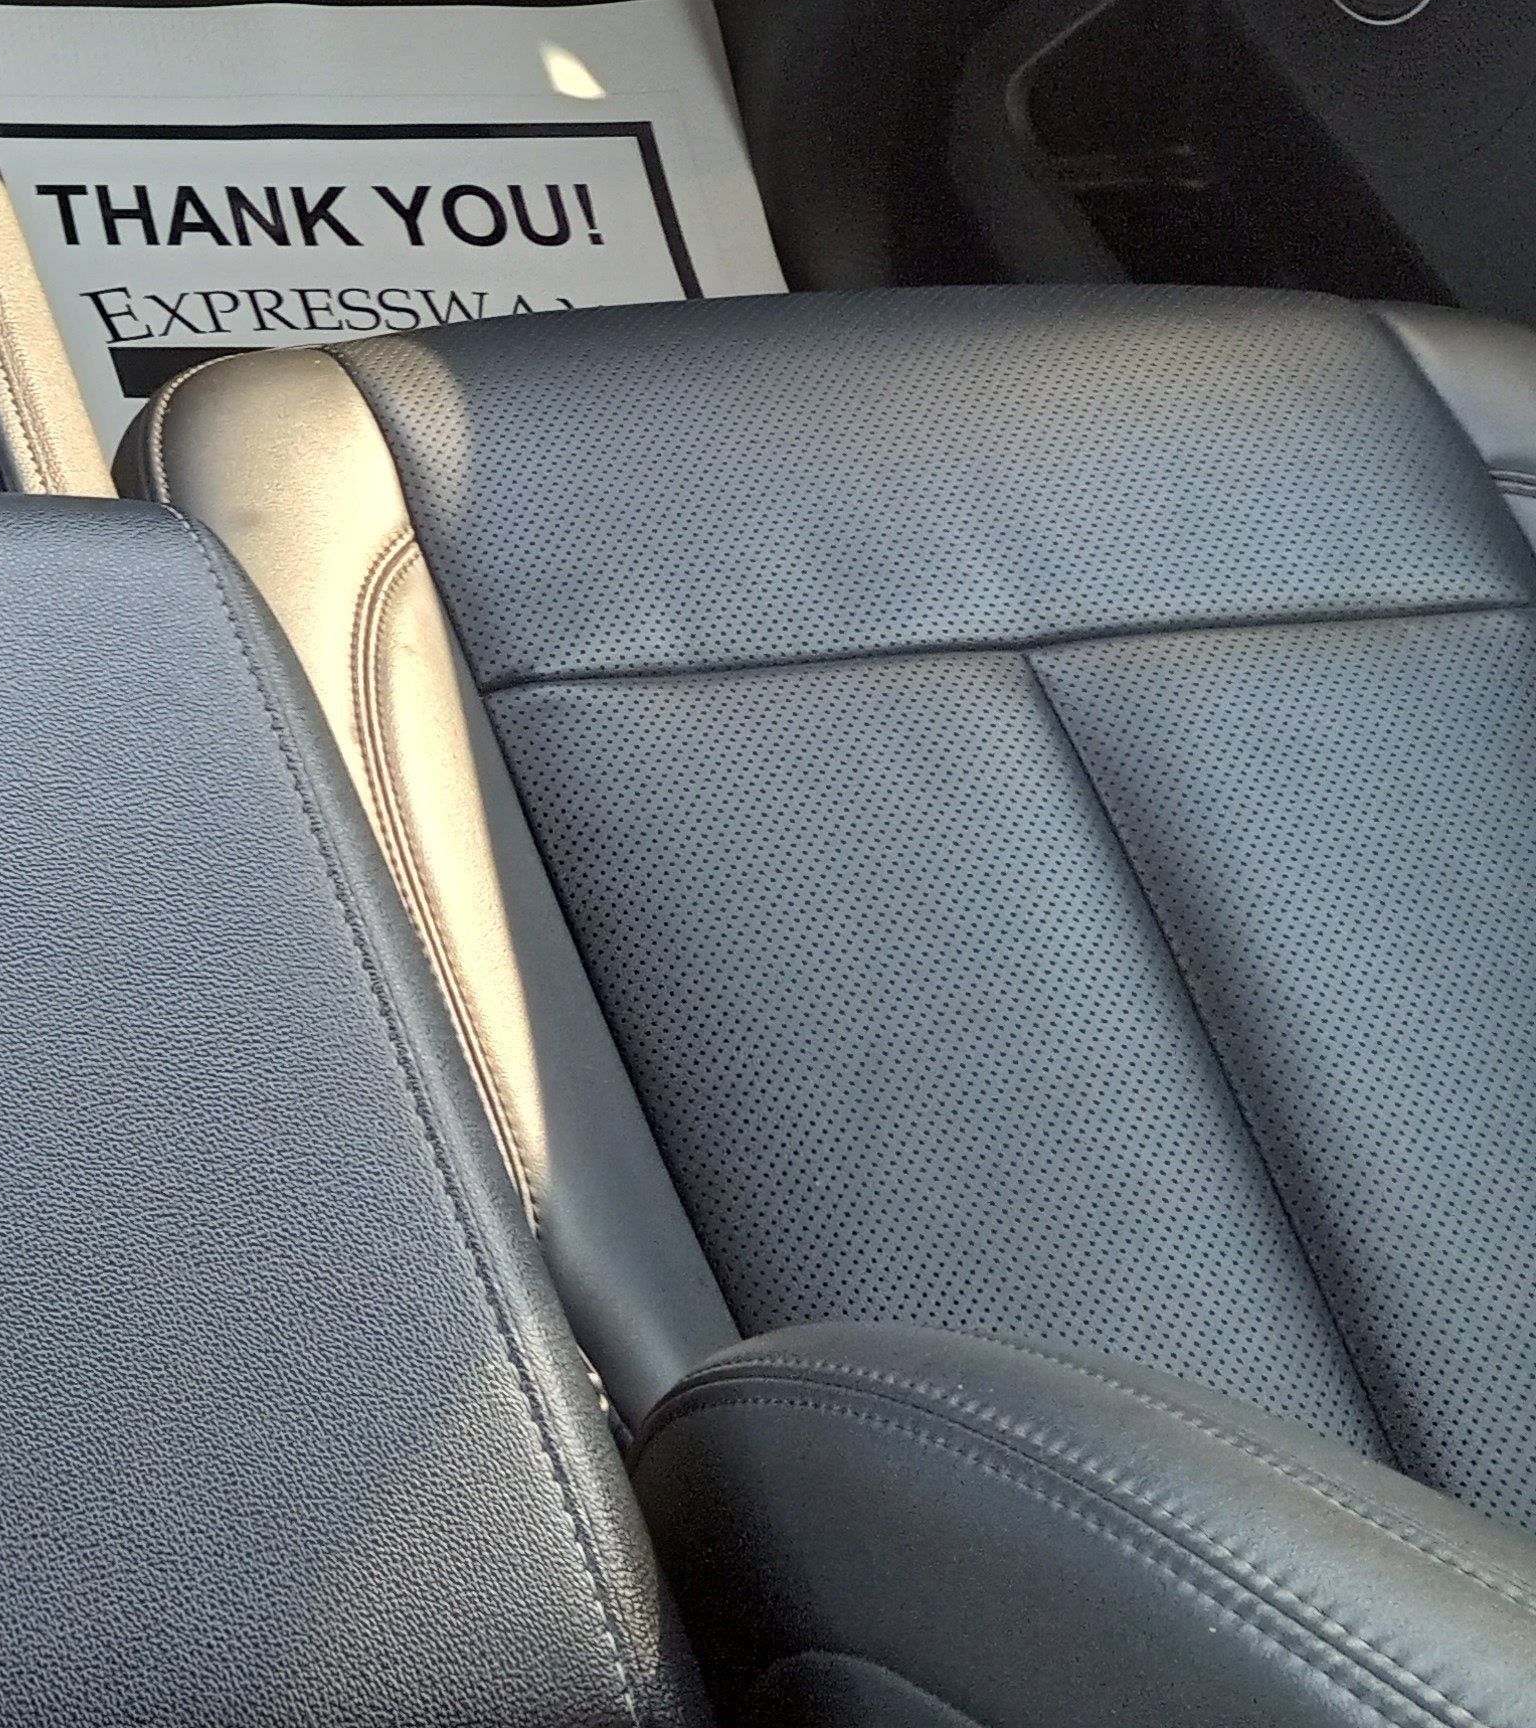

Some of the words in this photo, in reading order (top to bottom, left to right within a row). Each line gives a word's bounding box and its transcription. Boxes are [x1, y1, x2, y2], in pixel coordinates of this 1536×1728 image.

[35, 183, 362, 247] THANK
[375, 183, 605, 247] YOU!
[80, 286, 573, 345] EXPRESSW
